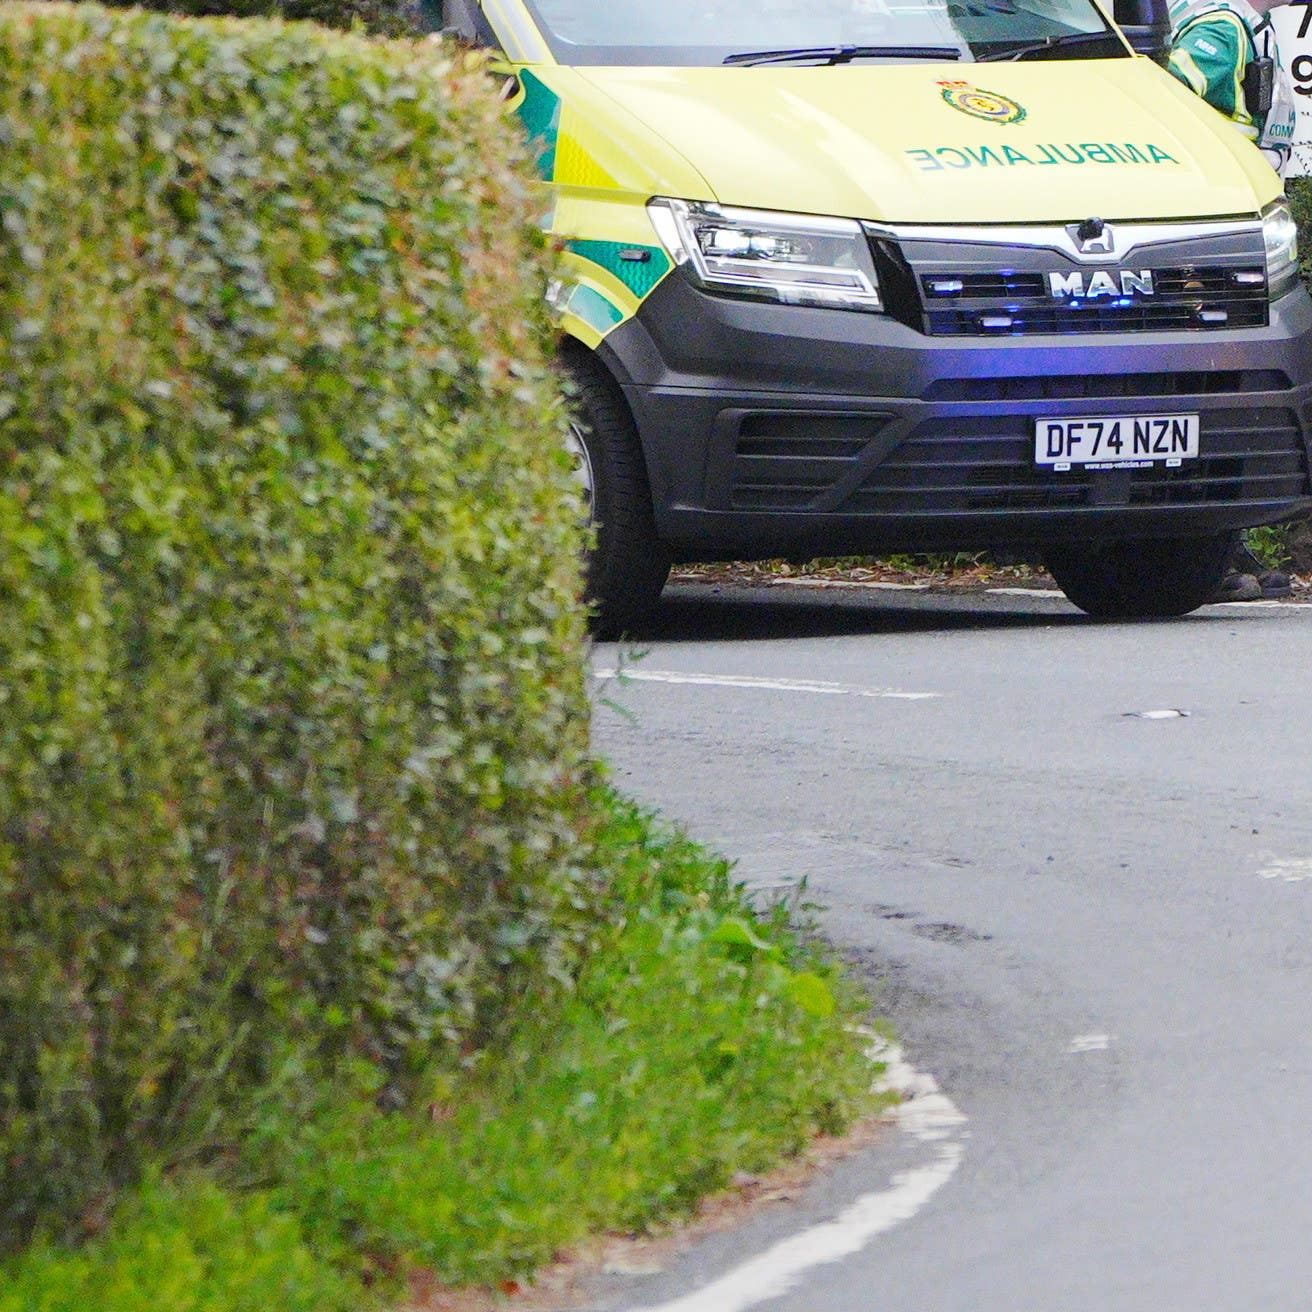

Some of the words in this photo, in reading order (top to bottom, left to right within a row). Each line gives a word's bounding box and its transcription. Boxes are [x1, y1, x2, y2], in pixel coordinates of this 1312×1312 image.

[1050, 270, 1154, 297] MAN
[1046, 422, 1123, 457] DF74
[1133, 419, 1188, 454] NZN
